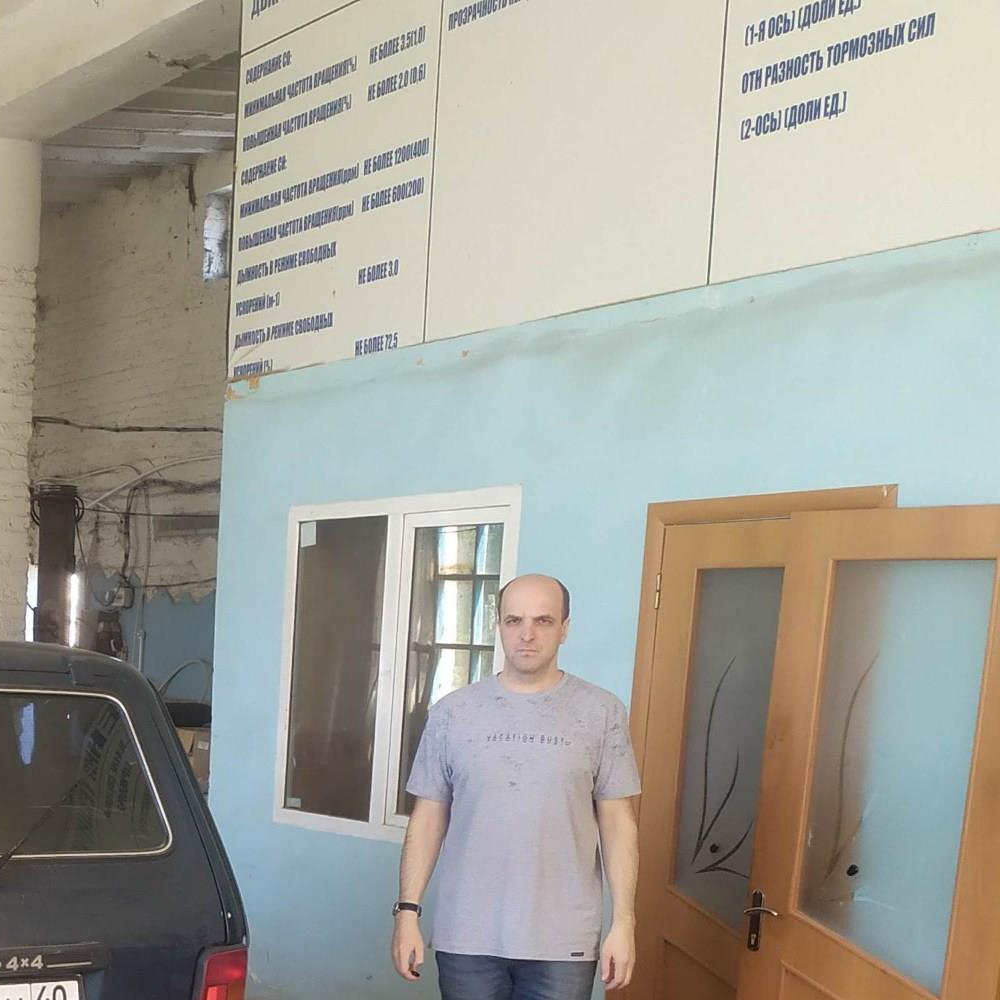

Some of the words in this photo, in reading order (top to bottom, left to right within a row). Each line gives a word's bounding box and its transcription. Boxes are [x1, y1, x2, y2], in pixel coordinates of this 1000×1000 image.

[767, 10, 796, 39] ОСЬ)
[369, 46, 378, 64] НЕ
[378, 37, 400, 60] БОЛЕЕ
[741, 68, 763, 94] ОТН
[764, 49, 823, 88] РАЗНОСТЬ
[826, 22, 906, 68] ТОРМОЗНЫХ
[907, 12, 936, 43] СИЛ
[245, 54, 282, 85] СОДЕРЖАНИЕ
[243, 86, 287, 119] МИНИМАЛЬНАЯ
[287, 75, 313, 99] ЧАСТОТА
[367, 84, 376, 102] НЕ
[377, 74, 397, 97] БОЛЕЕ
[242, 123, 282, 152] ПОВЫШЕННАЯ
[282, 111, 308, 135] ЧАСТОТА
[740, 110, 782, 141] (2-ОСЬ)
[783, 96, 822, 130] (ДОЛИ
[241, 158, 277, 186] СОДЕРЖАНИЕ
[363, 158, 372, 176] НЕ
[372, 150, 393, 173] БОЛЕЕ
[240, 191, 282, 218] МИНИМАЛЬНАЯ
[282, 181, 308, 203] ЧАСТОТА
[361, 194, 371, 212] НЕ
[371, 187, 391, 210] БОЛЕЕ
[238, 225, 277, 251] ПОВЫШЕННАЯ
[278, 216, 303, 239] ЧАСТОТА
[236, 262, 268, 286] ДЫМНОСТЬ
[274, 253, 298, 272] РЕЖИМЕ
[298, 241, 337, 267] СВОБОДНЫХ
[358, 267, 367, 285] НЕ
[367, 261, 387, 282] БОЛЕЕ
[235, 293, 266, 317] УСКОРЕНИЙ
[234, 328, 265, 351] ДЫМНОСТЬ
[271, 321, 294, 340] РЕЖИМЕ
[294, 312, 333, 335] СВОБОДНЫХ
[355, 340, 363, 357] НЕ
[363, 336, 384, 355] БОЛЕЕ
